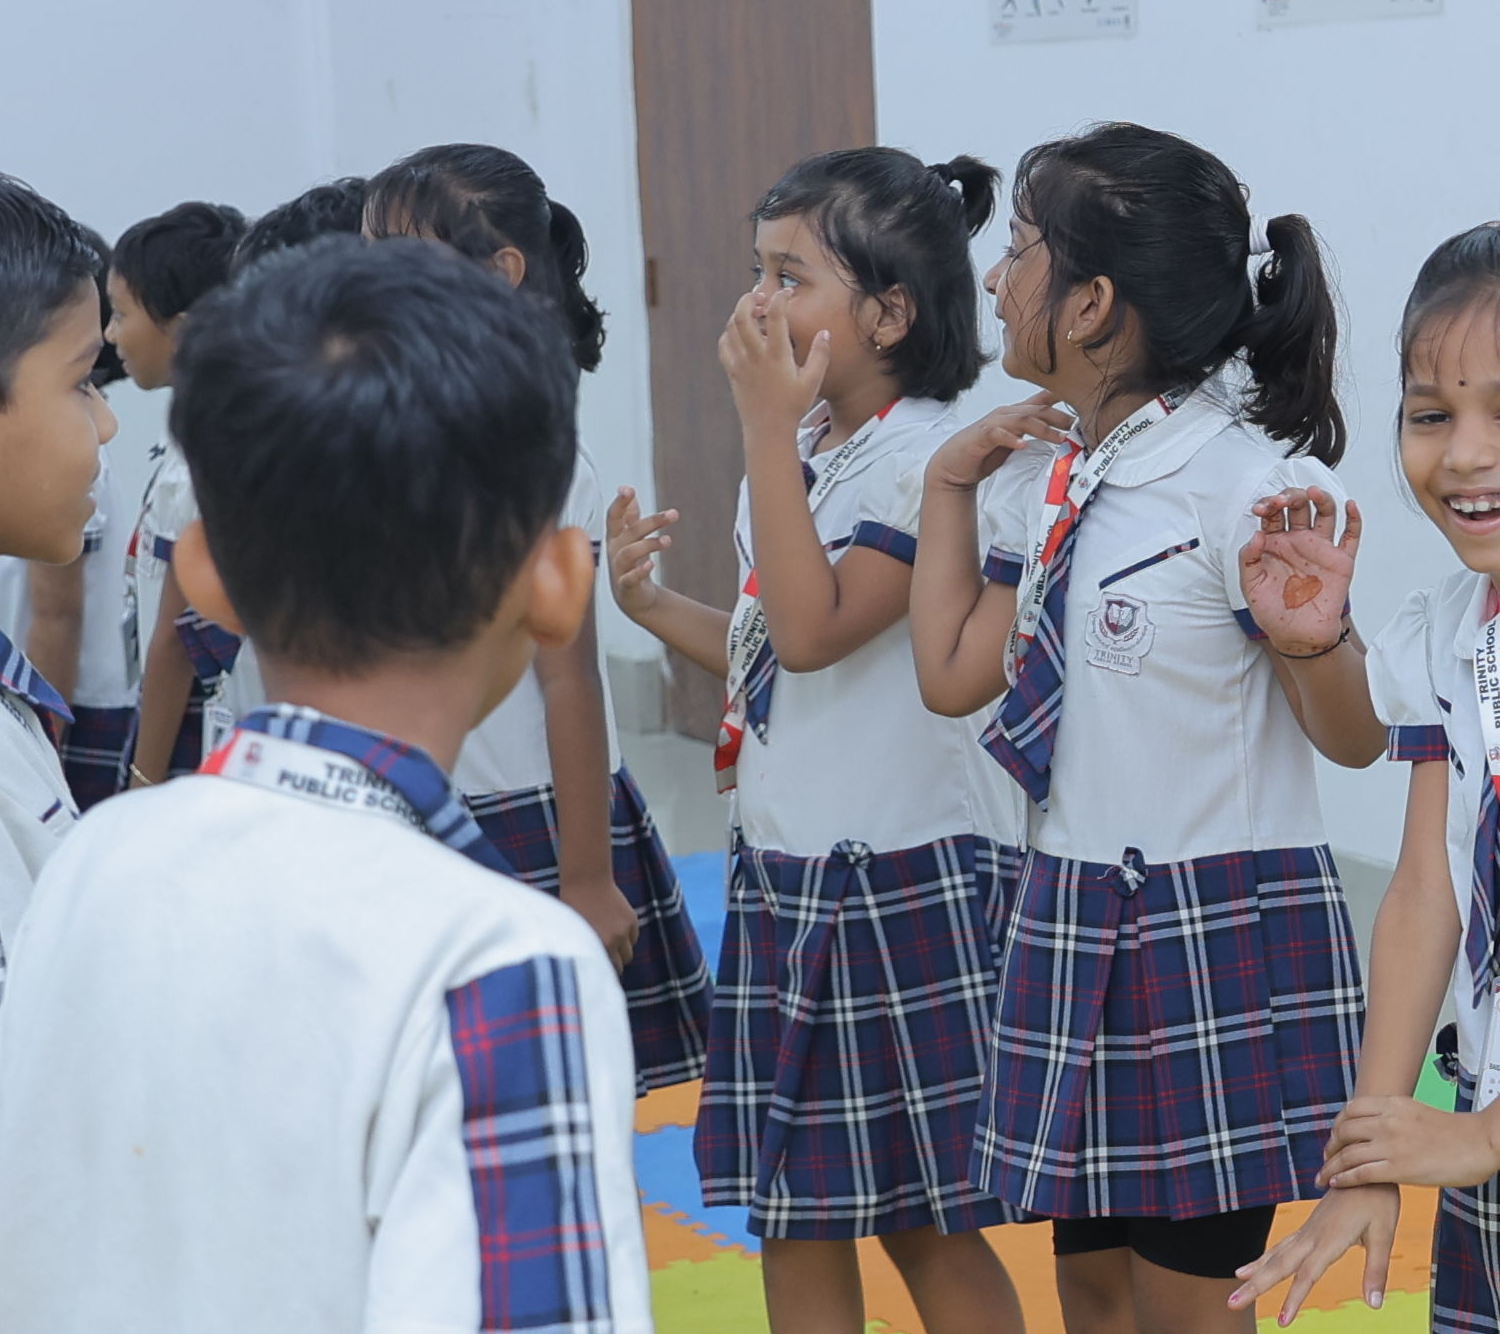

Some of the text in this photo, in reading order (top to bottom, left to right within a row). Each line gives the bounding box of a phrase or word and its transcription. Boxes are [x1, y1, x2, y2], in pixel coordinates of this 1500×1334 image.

[1093, 418, 1154, 477] PUBLIC SCHOOL
[1099, 421, 1130, 455] TRINITY
[823, 439, 855, 473] TRINITY
[817, 461, 844, 496] PUBLIC
[742, 609, 764, 648] TRINITY
[741, 636, 763, 672] PUBLIC
[1095, 649, 1135, 664] TRINITY
[1486, 620, 1497, 673] SCHOOL
[1476, 647, 1490, 703] TRINITY
[278, 770, 358, 805] PUBLIC
[324, 762, 403, 797] TRIN
